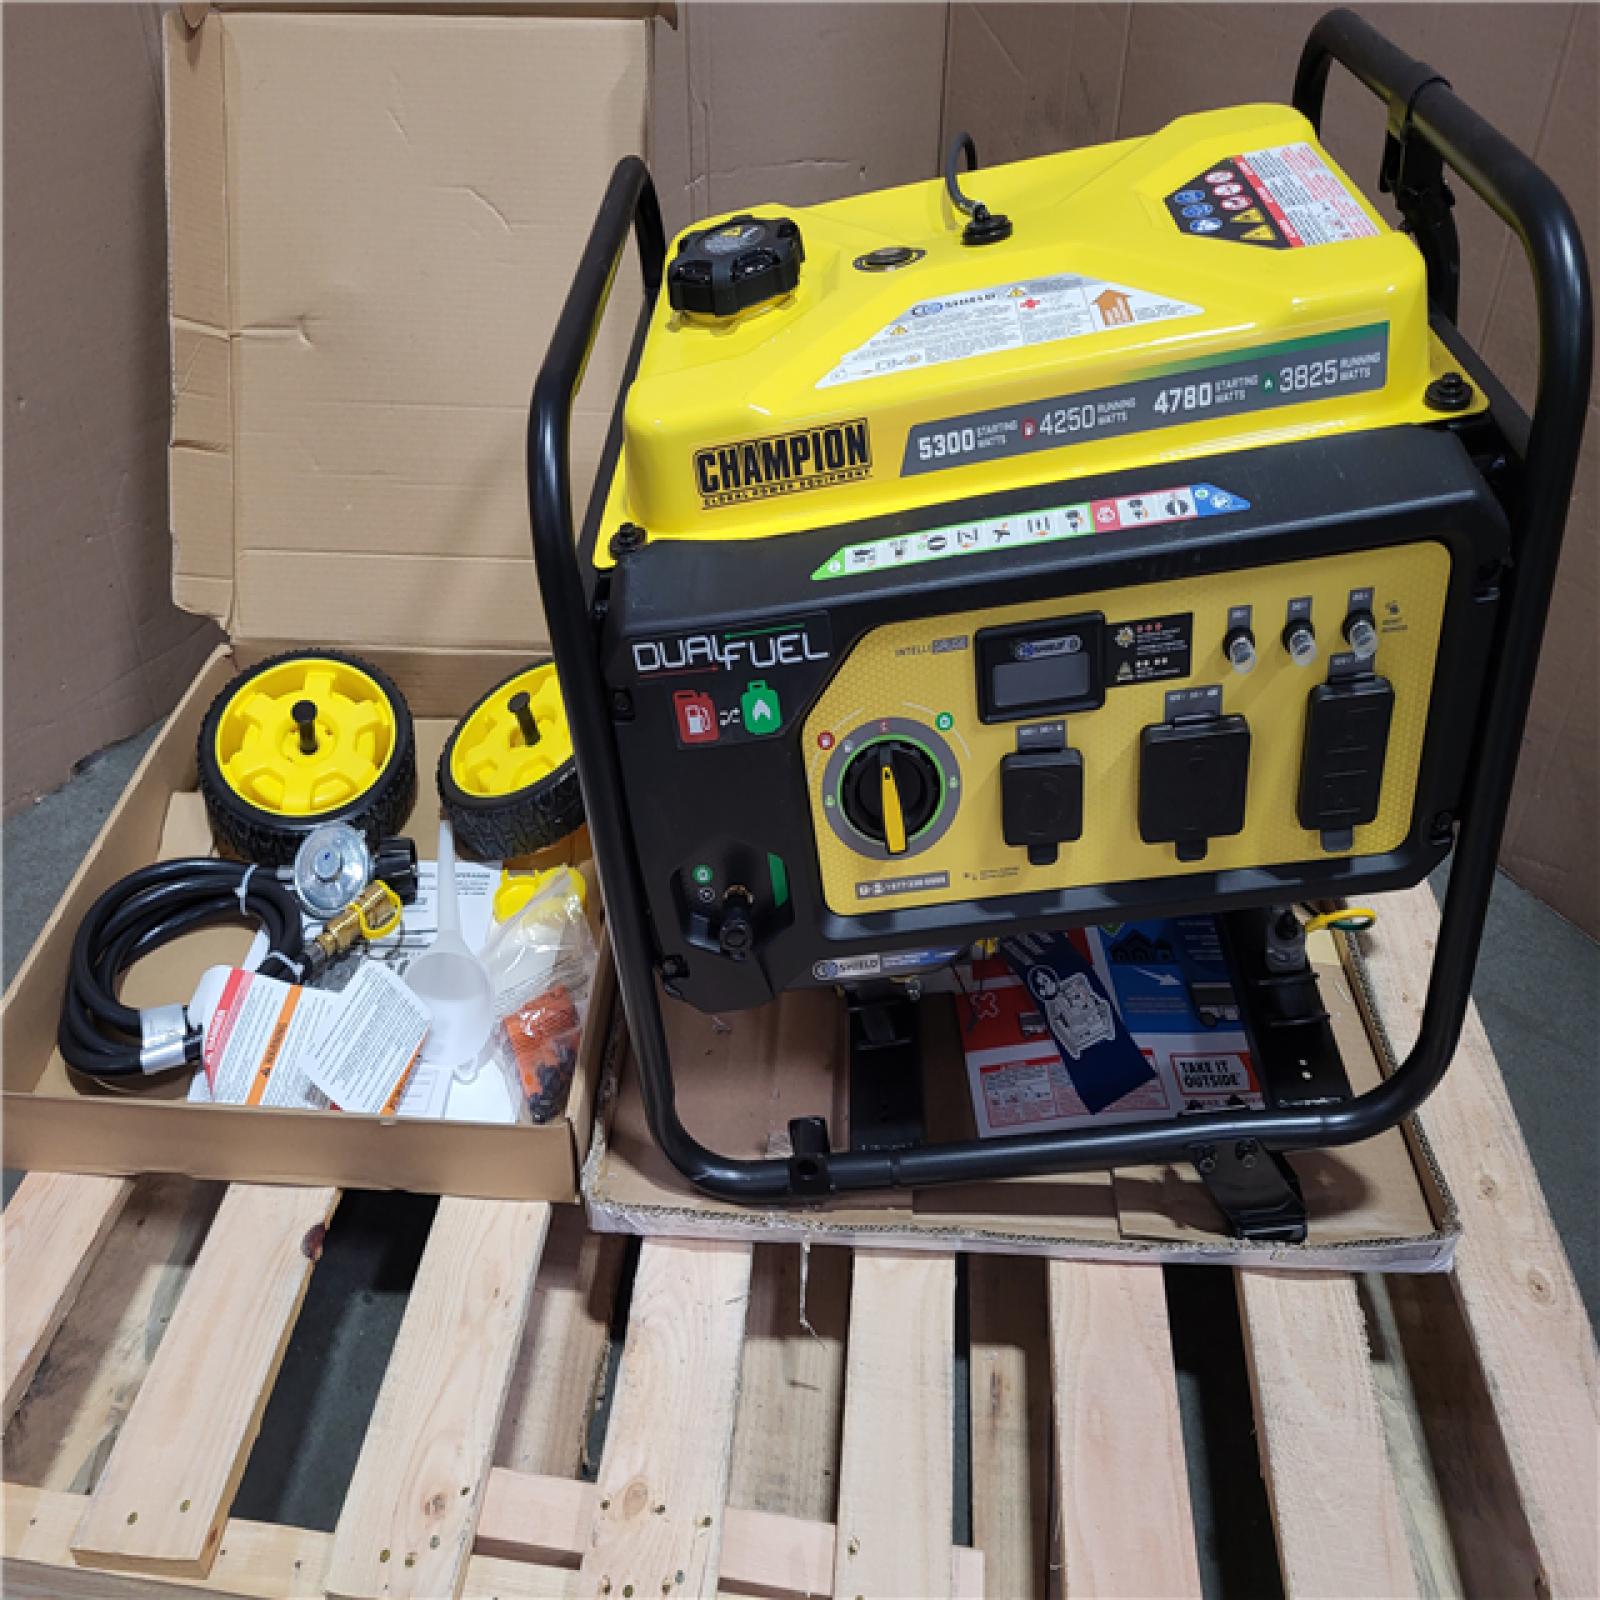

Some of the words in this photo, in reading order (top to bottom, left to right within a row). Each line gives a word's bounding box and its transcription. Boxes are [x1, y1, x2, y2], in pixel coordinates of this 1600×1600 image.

[1280, 359, 1338, 393] 3825
[1154, 381, 1213, 414] 4780
[1040, 404, 1096, 436] 4250
[697, 424, 869, 494] CHAMPION
[918, 428, 976, 461] 5300
[1180, 1061, 1212, 1073] TAKE
[1214, 1060, 1228, 1073] IT
